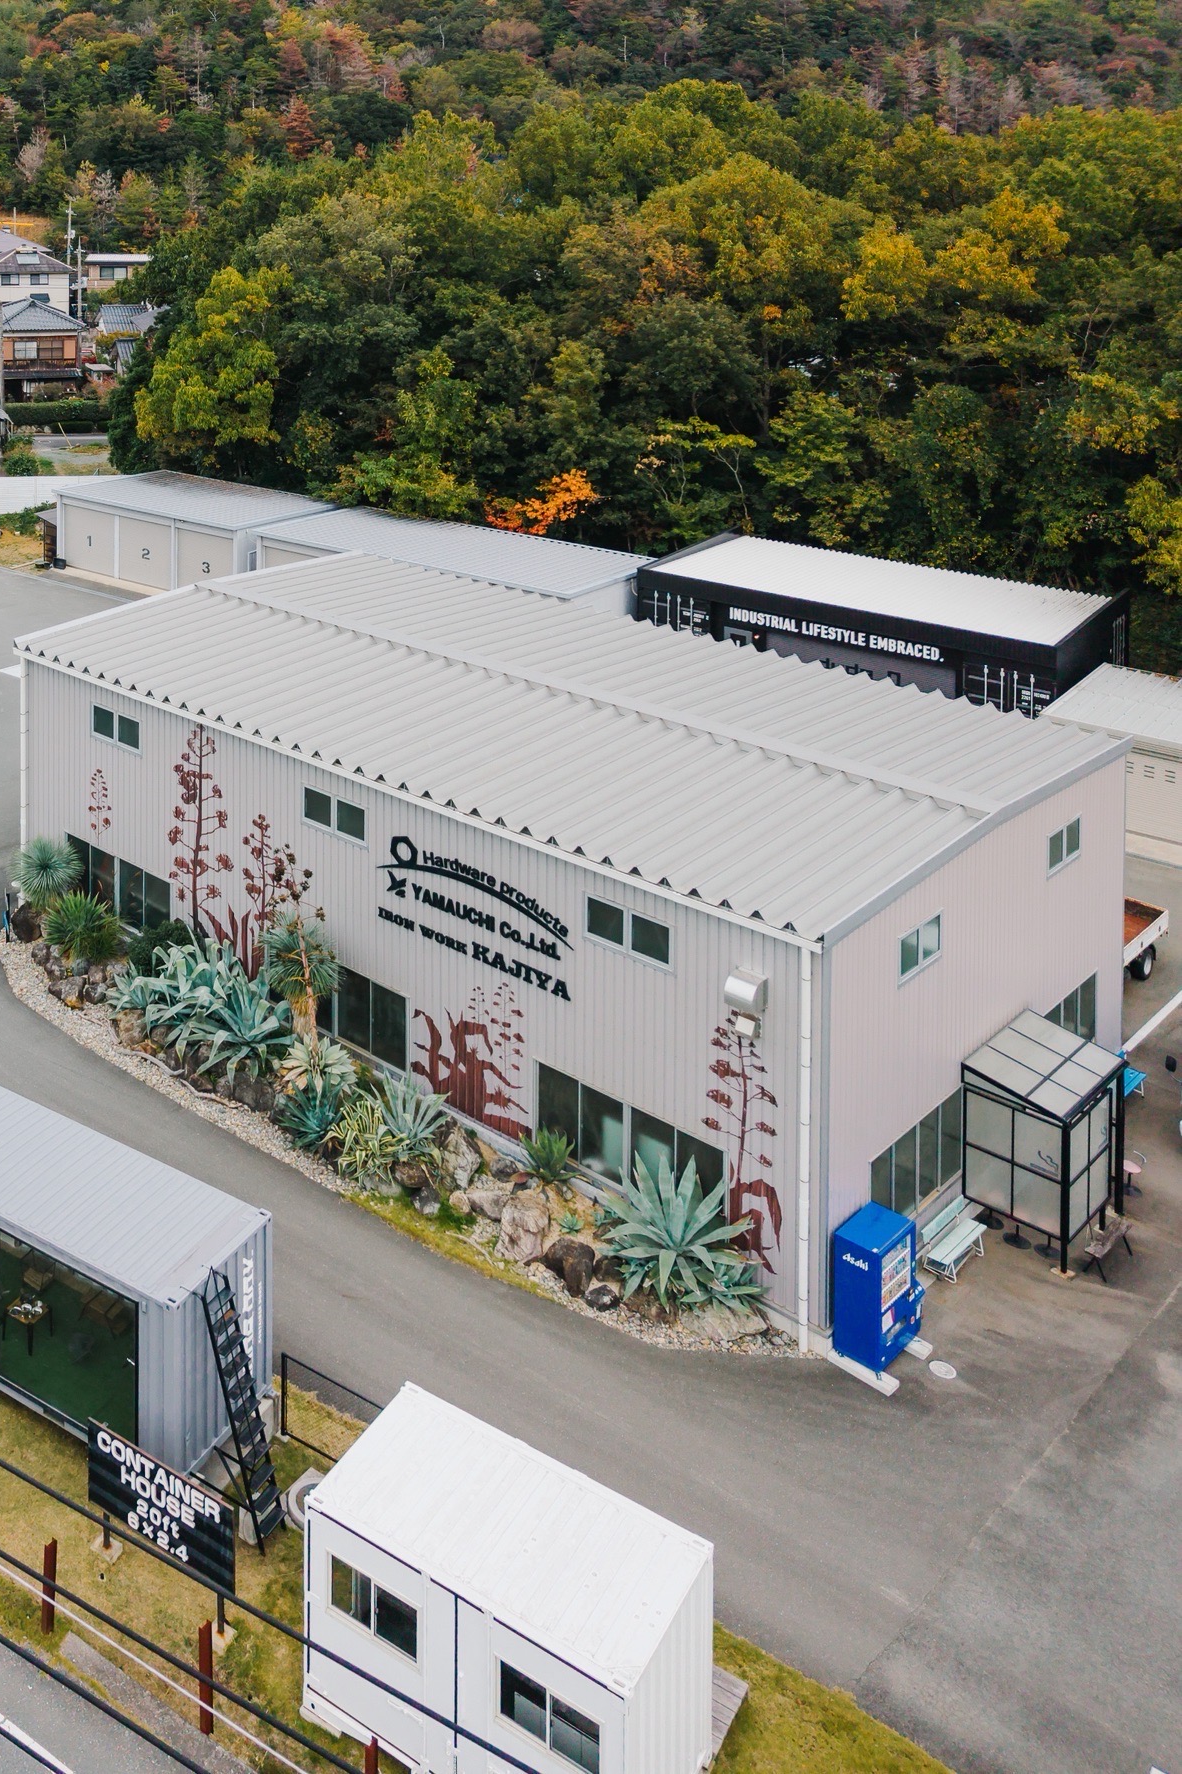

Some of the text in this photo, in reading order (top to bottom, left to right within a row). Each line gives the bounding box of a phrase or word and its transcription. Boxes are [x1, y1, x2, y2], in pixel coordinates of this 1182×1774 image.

[86, 535, 92, 547] 1
[141, 548, 150, 560] 2
[201, 561, 211, 574] 3
[729, 606, 799, 633] INDUSTRIAL
[801, 620, 866, 646] LIFESTYLE
[869, 634, 945, 662] EMBRACED.
[411, 882, 495, 933] YAMAUCHI
[422, 850, 569, 938] Hardware products
[378, 906, 571, 1002] IRON WORK KAJIYA
[842, 1253, 868, 1271] Asahi
[96, 1430, 221, 1524] CONTAINER
[120, 1465, 195, 1528] HOUSE
[136, 1498, 180, 1539] 20ft
